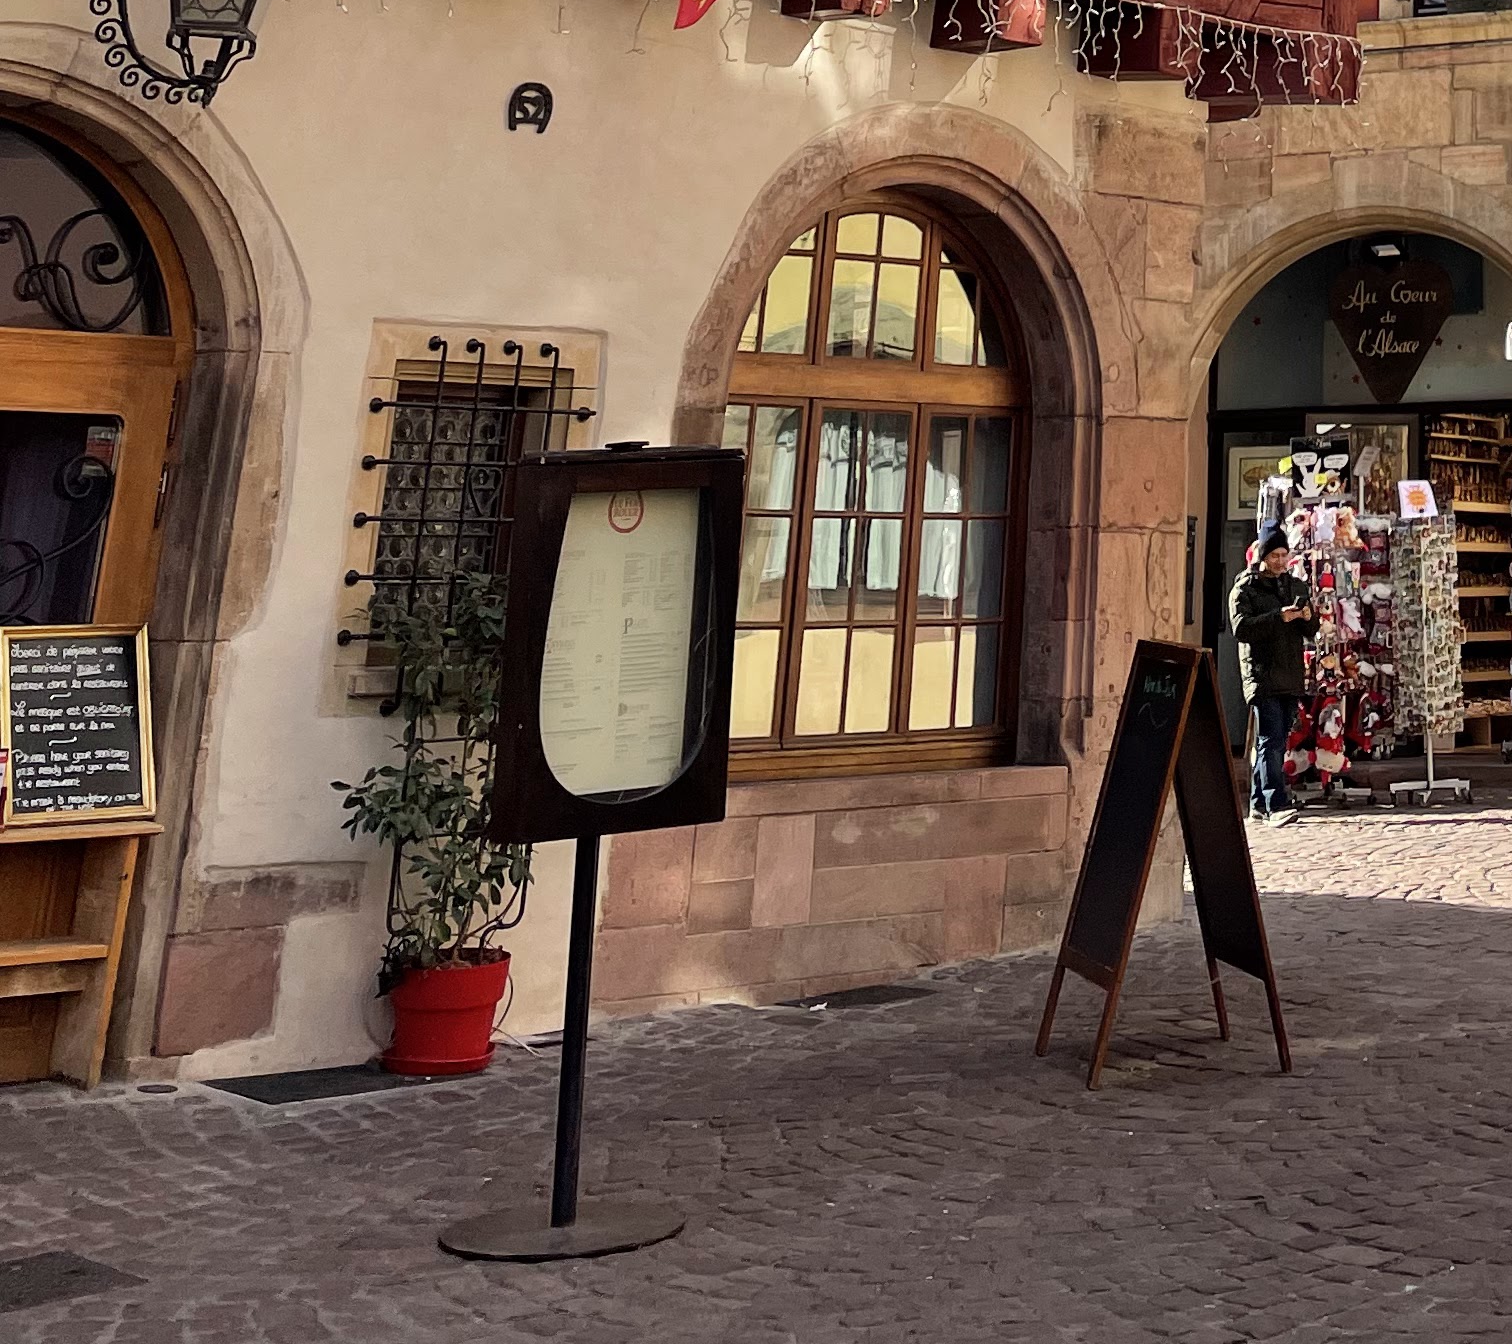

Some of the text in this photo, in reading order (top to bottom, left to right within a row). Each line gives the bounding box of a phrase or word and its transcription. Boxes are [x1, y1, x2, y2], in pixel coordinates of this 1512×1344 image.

[1342, 280, 1438, 313] Au Coeur
[1380, 310, 1397, 324] de
[1356, 328, 1420, 358] l'Alsace
